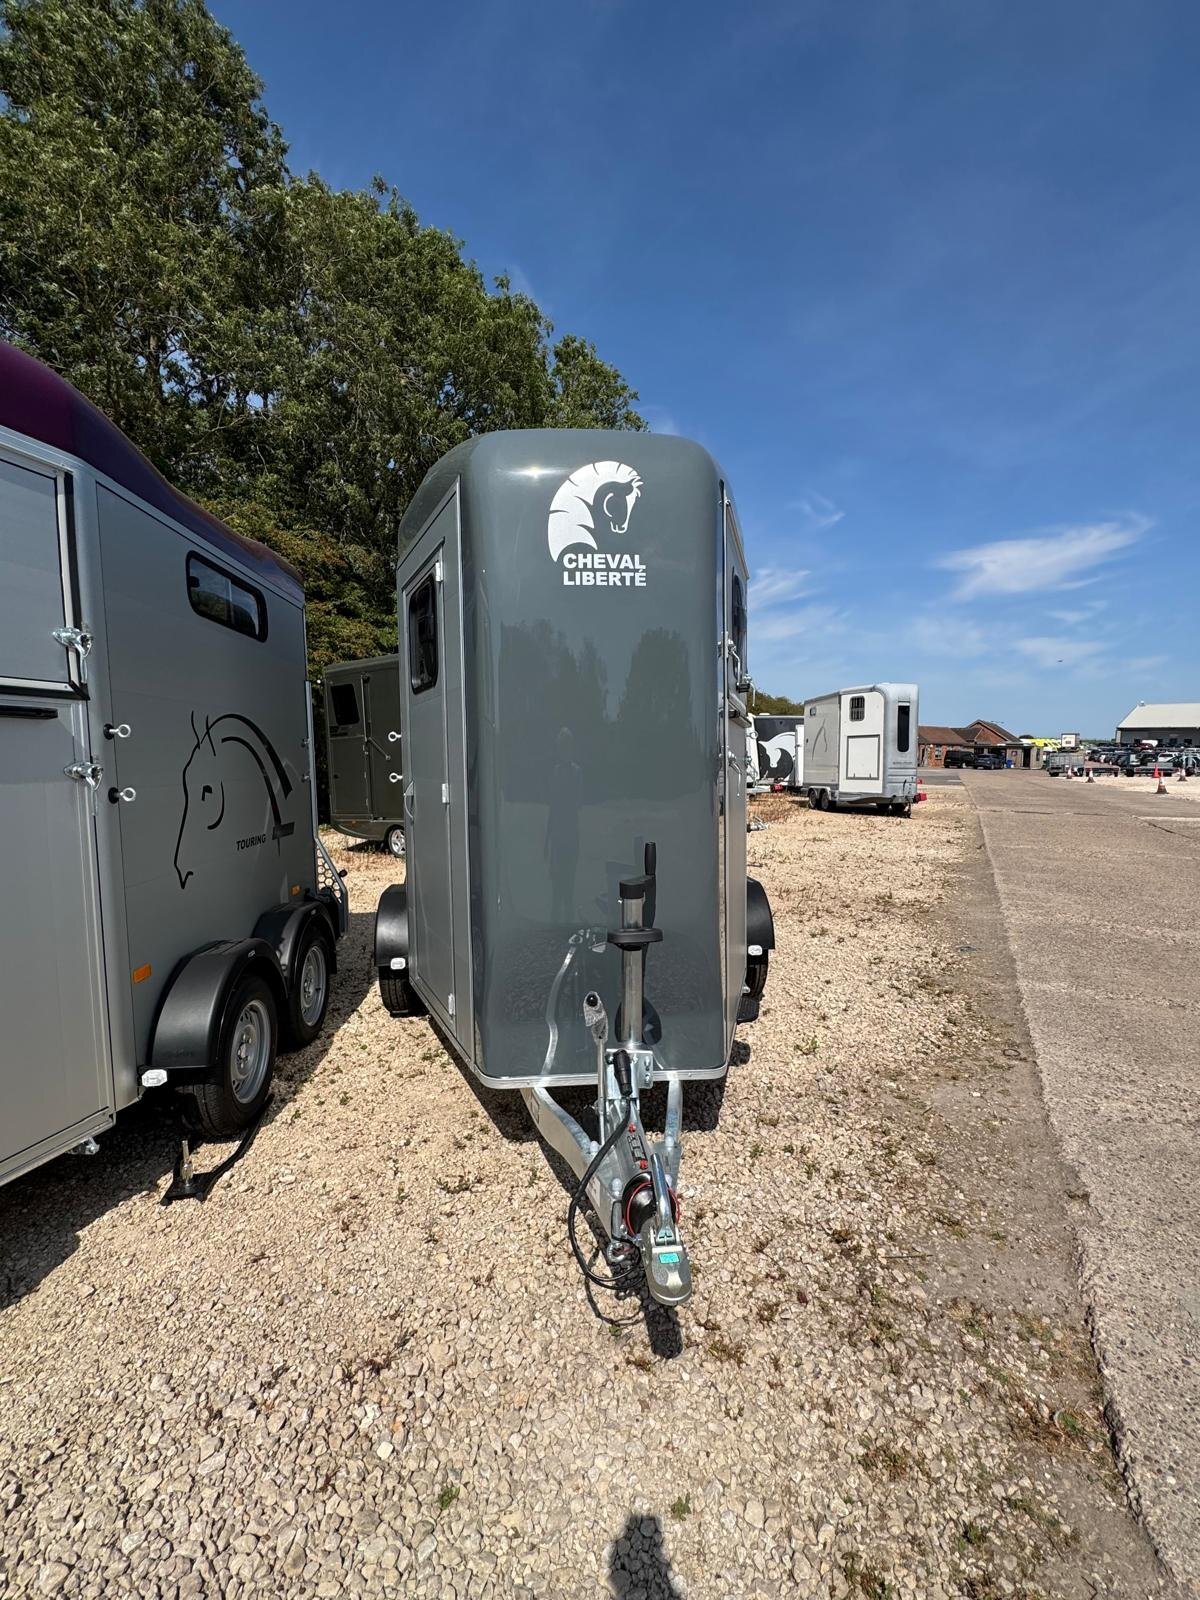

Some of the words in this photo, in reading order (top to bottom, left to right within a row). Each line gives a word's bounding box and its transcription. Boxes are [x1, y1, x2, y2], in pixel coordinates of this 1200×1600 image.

[563, 553, 646, 569] CHEVAL
[563, 569, 647, 586] LIBERTÉ
[236, 834, 266, 851] TOURING
